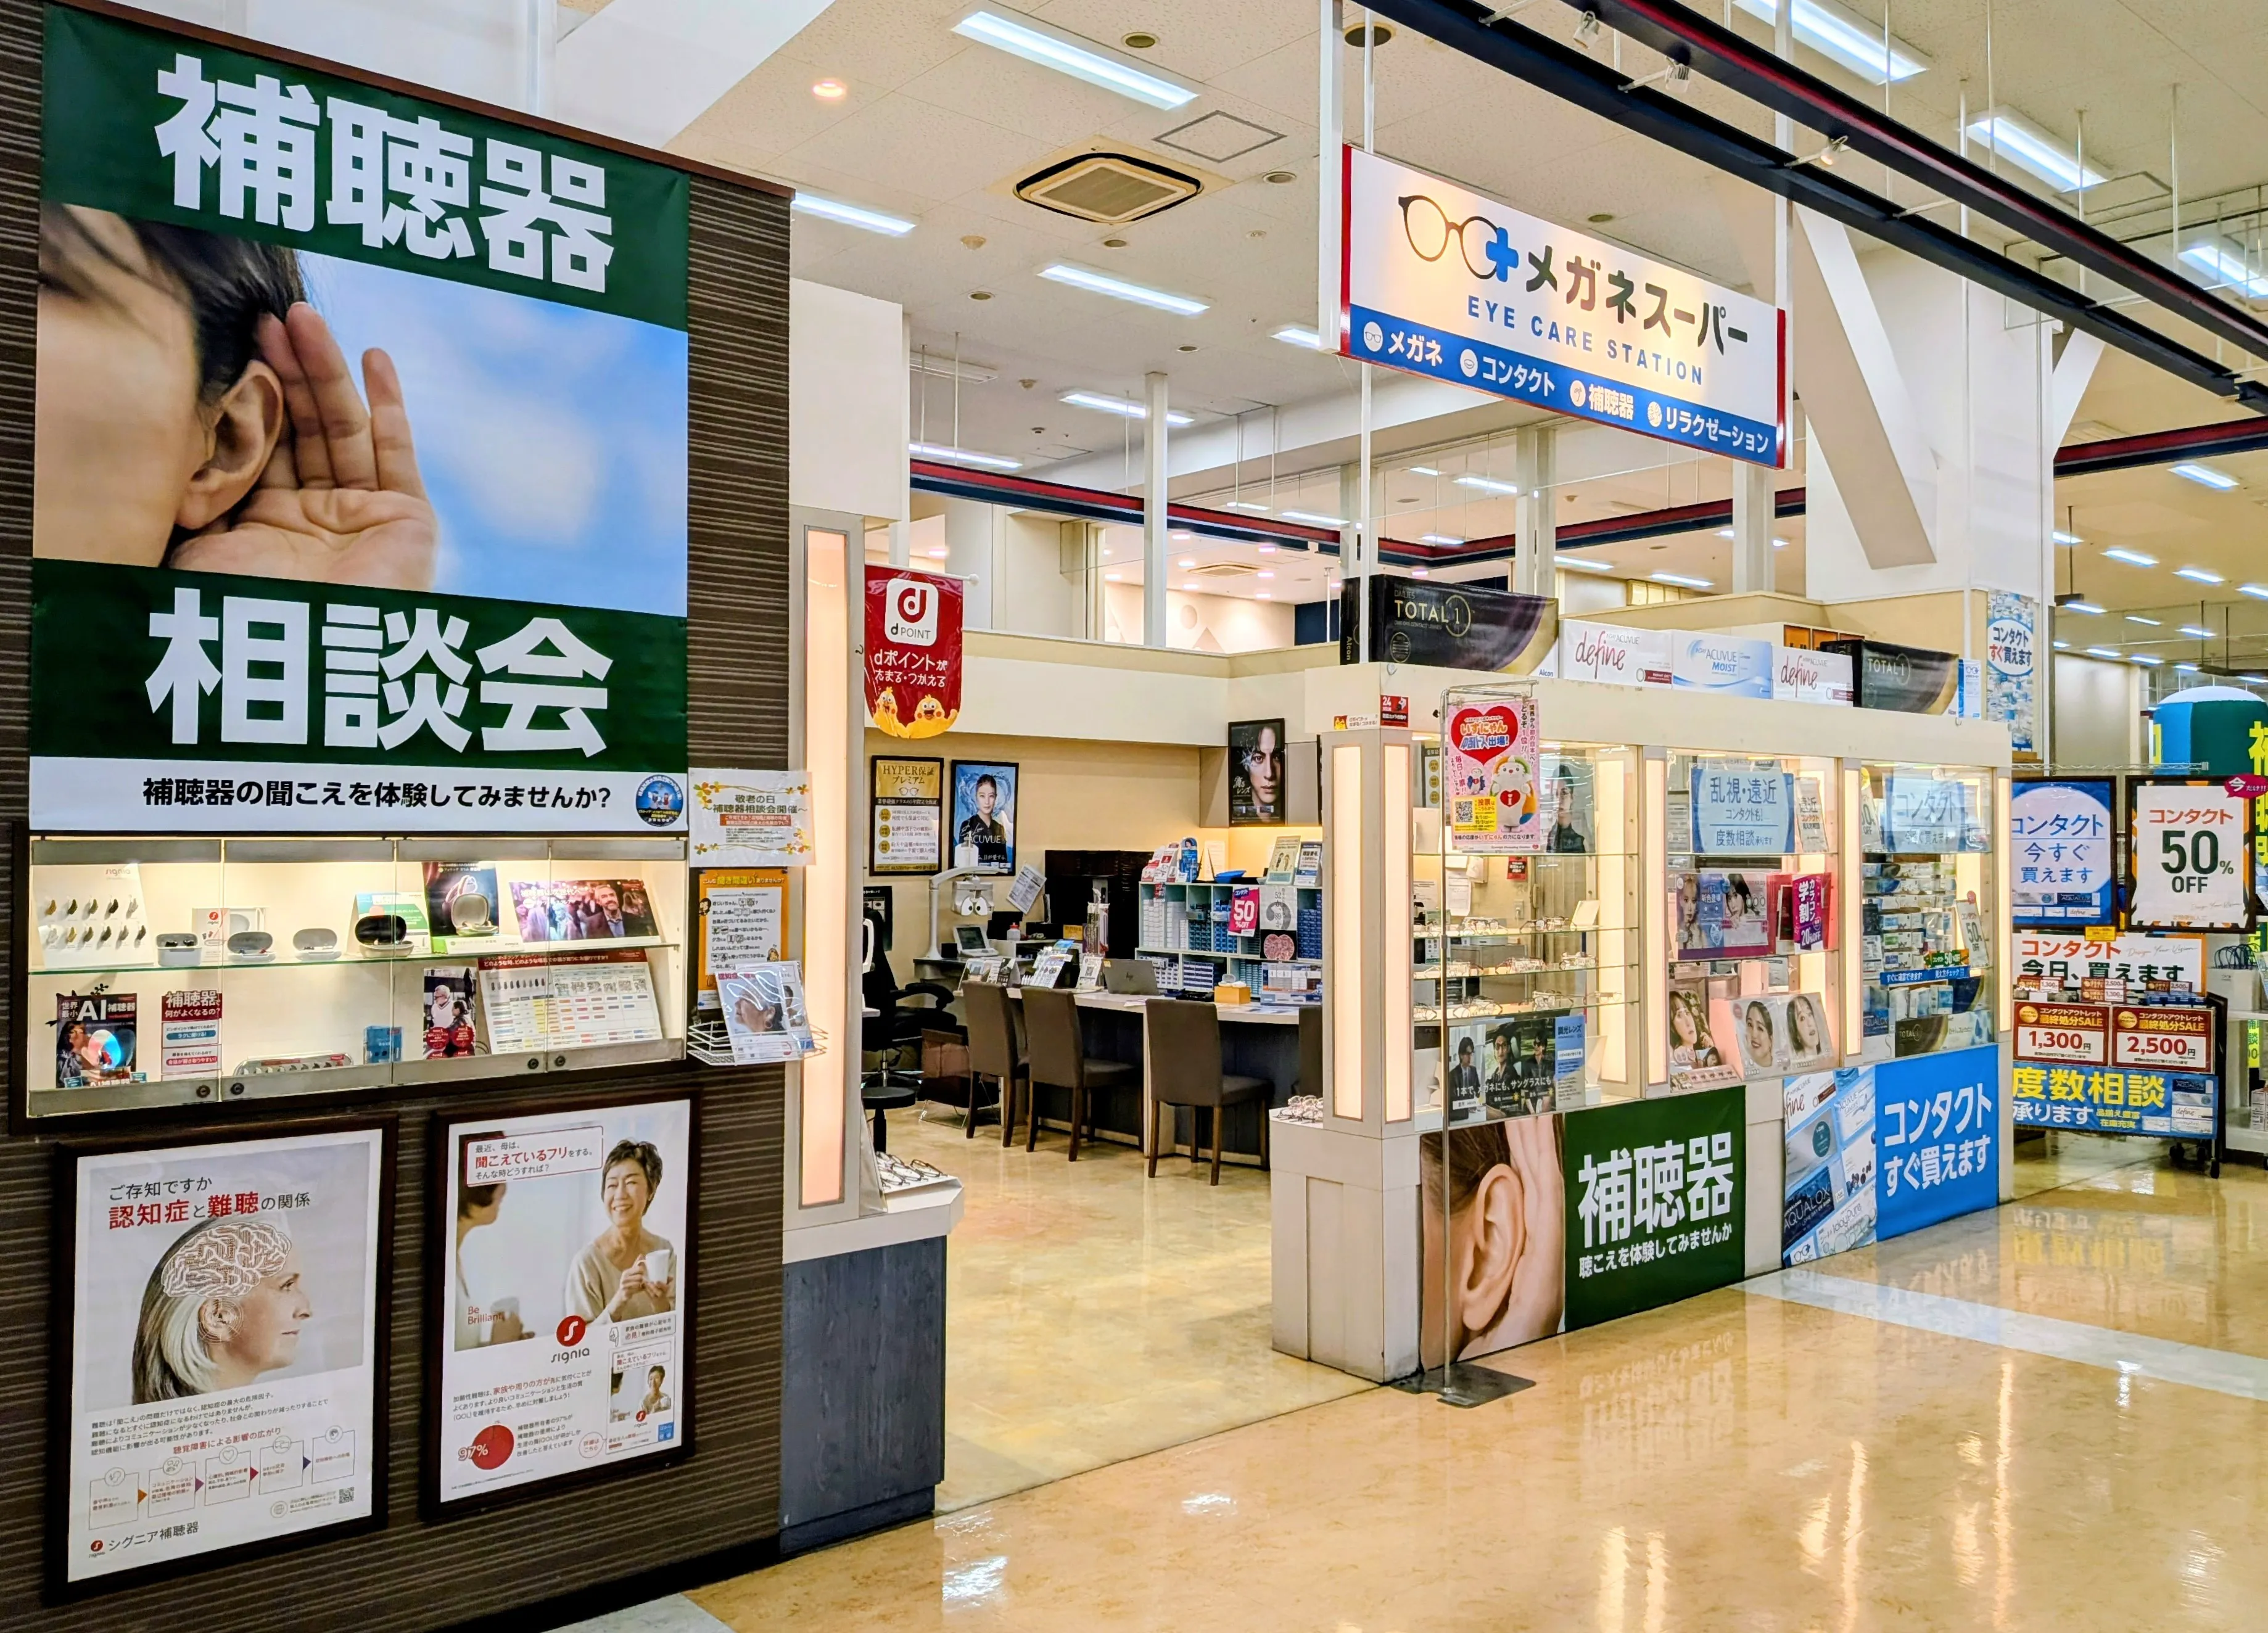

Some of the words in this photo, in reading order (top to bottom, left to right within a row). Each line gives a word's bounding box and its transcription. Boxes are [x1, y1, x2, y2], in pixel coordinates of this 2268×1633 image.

[154, 53, 613, 293] 補聴器
[1526, 245, 1748, 355] メガネスーパー
[1468, 296, 1515, 329] EYE
[1531, 315, 1593, 352] CARE
[1607, 339, 1702, 385] STATION
[1387, 330, 1443, 366] メガネ
[1482, 355, 1555, 397] コンタクト
[1588, 384, 1635, 421] 補聴器
[1666, 406, 1768, 454] リラクゼーション
[1395, 600, 1448, 623] TOTAL
[900, 627, 931, 639] POINT
[1993, 627, 2029, 648] コンタクト
[874, 649, 947, 671] dポイントが
[1575, 631, 1626, 679] define
[1705, 649, 1737, 662] ACUVUE
[1989, 644, 2032, 667] すぐ買えます
[144, 587, 613, 757] 相談会
[1539, 669, 1554, 677] Alcon
[1712, 662, 1736, 673] MOIST
[1781, 656, 1818, 698] define
[1868, 658, 1899, 675] TOTAL
[883, 765, 934, 776] HYPER保証
[893, 776, 925, 784] プレミアム
[142, 778, 611, 810] 補聴器の聞こえを体験してみませんか?
[735, 794, 775, 804] 敬老の日
[1710, 776, 1776, 804] 乱視・遠近
[1725, 808, 1763, 821] コンタクトも!
[2011, 813, 2104, 836] コンタクト
[2149, 808, 2234, 826] コンタクト
[2024, 841, 2090, 863] 今すぐ
[2161, 829, 2234, 874] 50%
[2020, 866, 2093, 884] 買えます
[2172, 876, 2208, 894] OFF
[1234, 900, 1255, 921] 50
[1799, 882, 1809, 924] 学割
[2021, 940, 2121, 960] コンタクト
[2021, 959, 2185, 984] 今日、買えます
[76, 999, 107, 1021] AI
[108, 1003, 135, 1013] 補聴器
[165, 1008, 220, 1018] 何がよくなるの?
[2040, 1008, 2102, 1018] コンタクトアウトレット
[2040, 1015, 2103, 1027] 最終処分SALE
[2139, 1013, 2203, 1022] コンタクトアウトレット
[2139, 1020, 2204, 1032] 最終処分SALE
[2013, 1066, 2166, 1108] 度数相談
[1883, 1084, 1992, 1148] コンタクト
[2013, 1101, 2093, 1125] 承ります
[476, 1142, 521, 1153] 最近、母は、
[476, 1147, 593, 1169] 聞こえているフリをする。
[475, 1164, 549, 1180] そんな時どうすれば?
[1883, 1135, 1991, 1196] すぐ買えます
[109, 1176, 212, 1201] ご存知ですか
[1578, 1132, 1733, 1248] 補聴器
[109, 1191, 310, 1230] 認知症と難聴の関係
[1579, 1224, 1733, 1278] 聴こえを体験してみませんか
[468, 1306, 479, 1315] Be
[551, 1347, 590, 1364] signia
[173, 1427, 281, 1454] 聴覚障害による影響の広がり
[458, 1444, 489, 1461] 97%
[109, 1521, 199, 1551] シグニア補聴器
